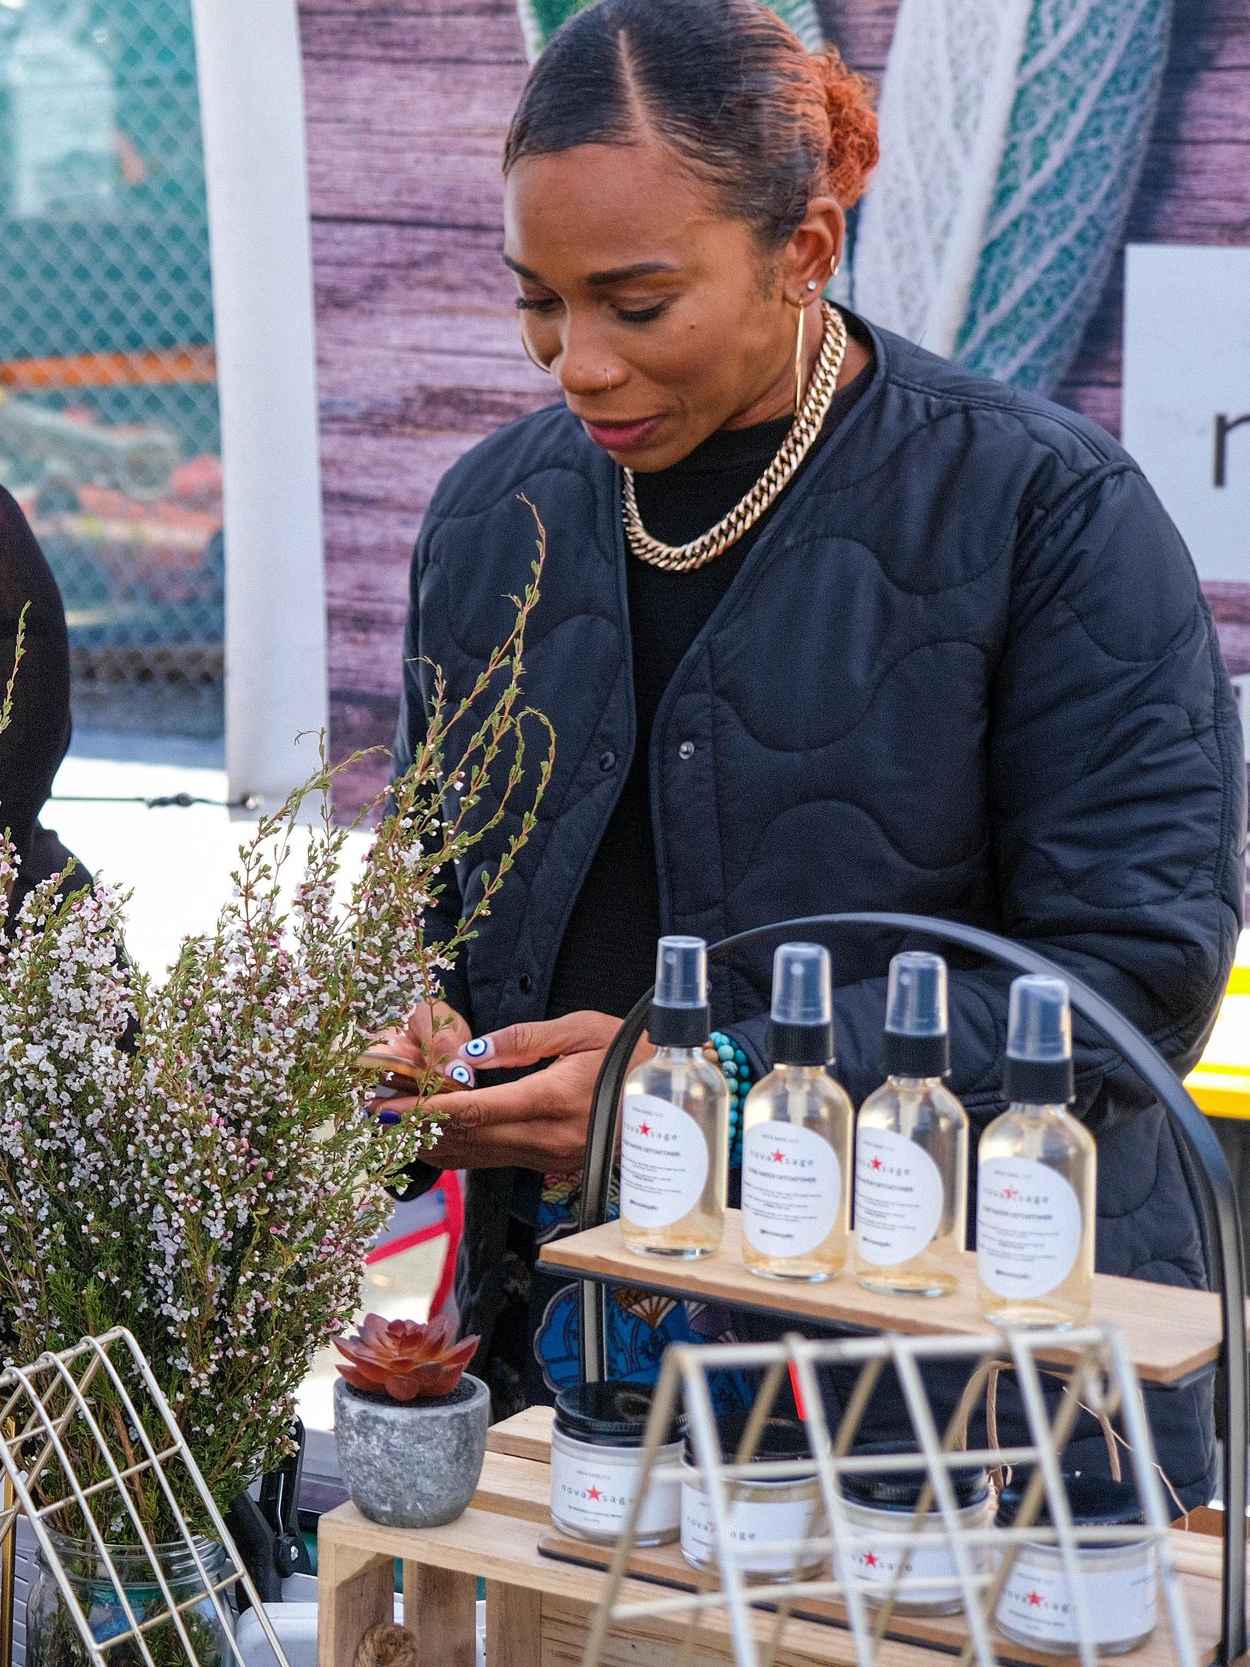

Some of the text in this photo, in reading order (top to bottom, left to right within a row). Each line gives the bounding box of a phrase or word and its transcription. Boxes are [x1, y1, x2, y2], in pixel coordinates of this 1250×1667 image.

[651, 1131, 678, 1142] sage
[785, 1157, 814, 1168] sage
[561, 1484, 586, 1498] nova
[730, 1530, 756, 1541] age
